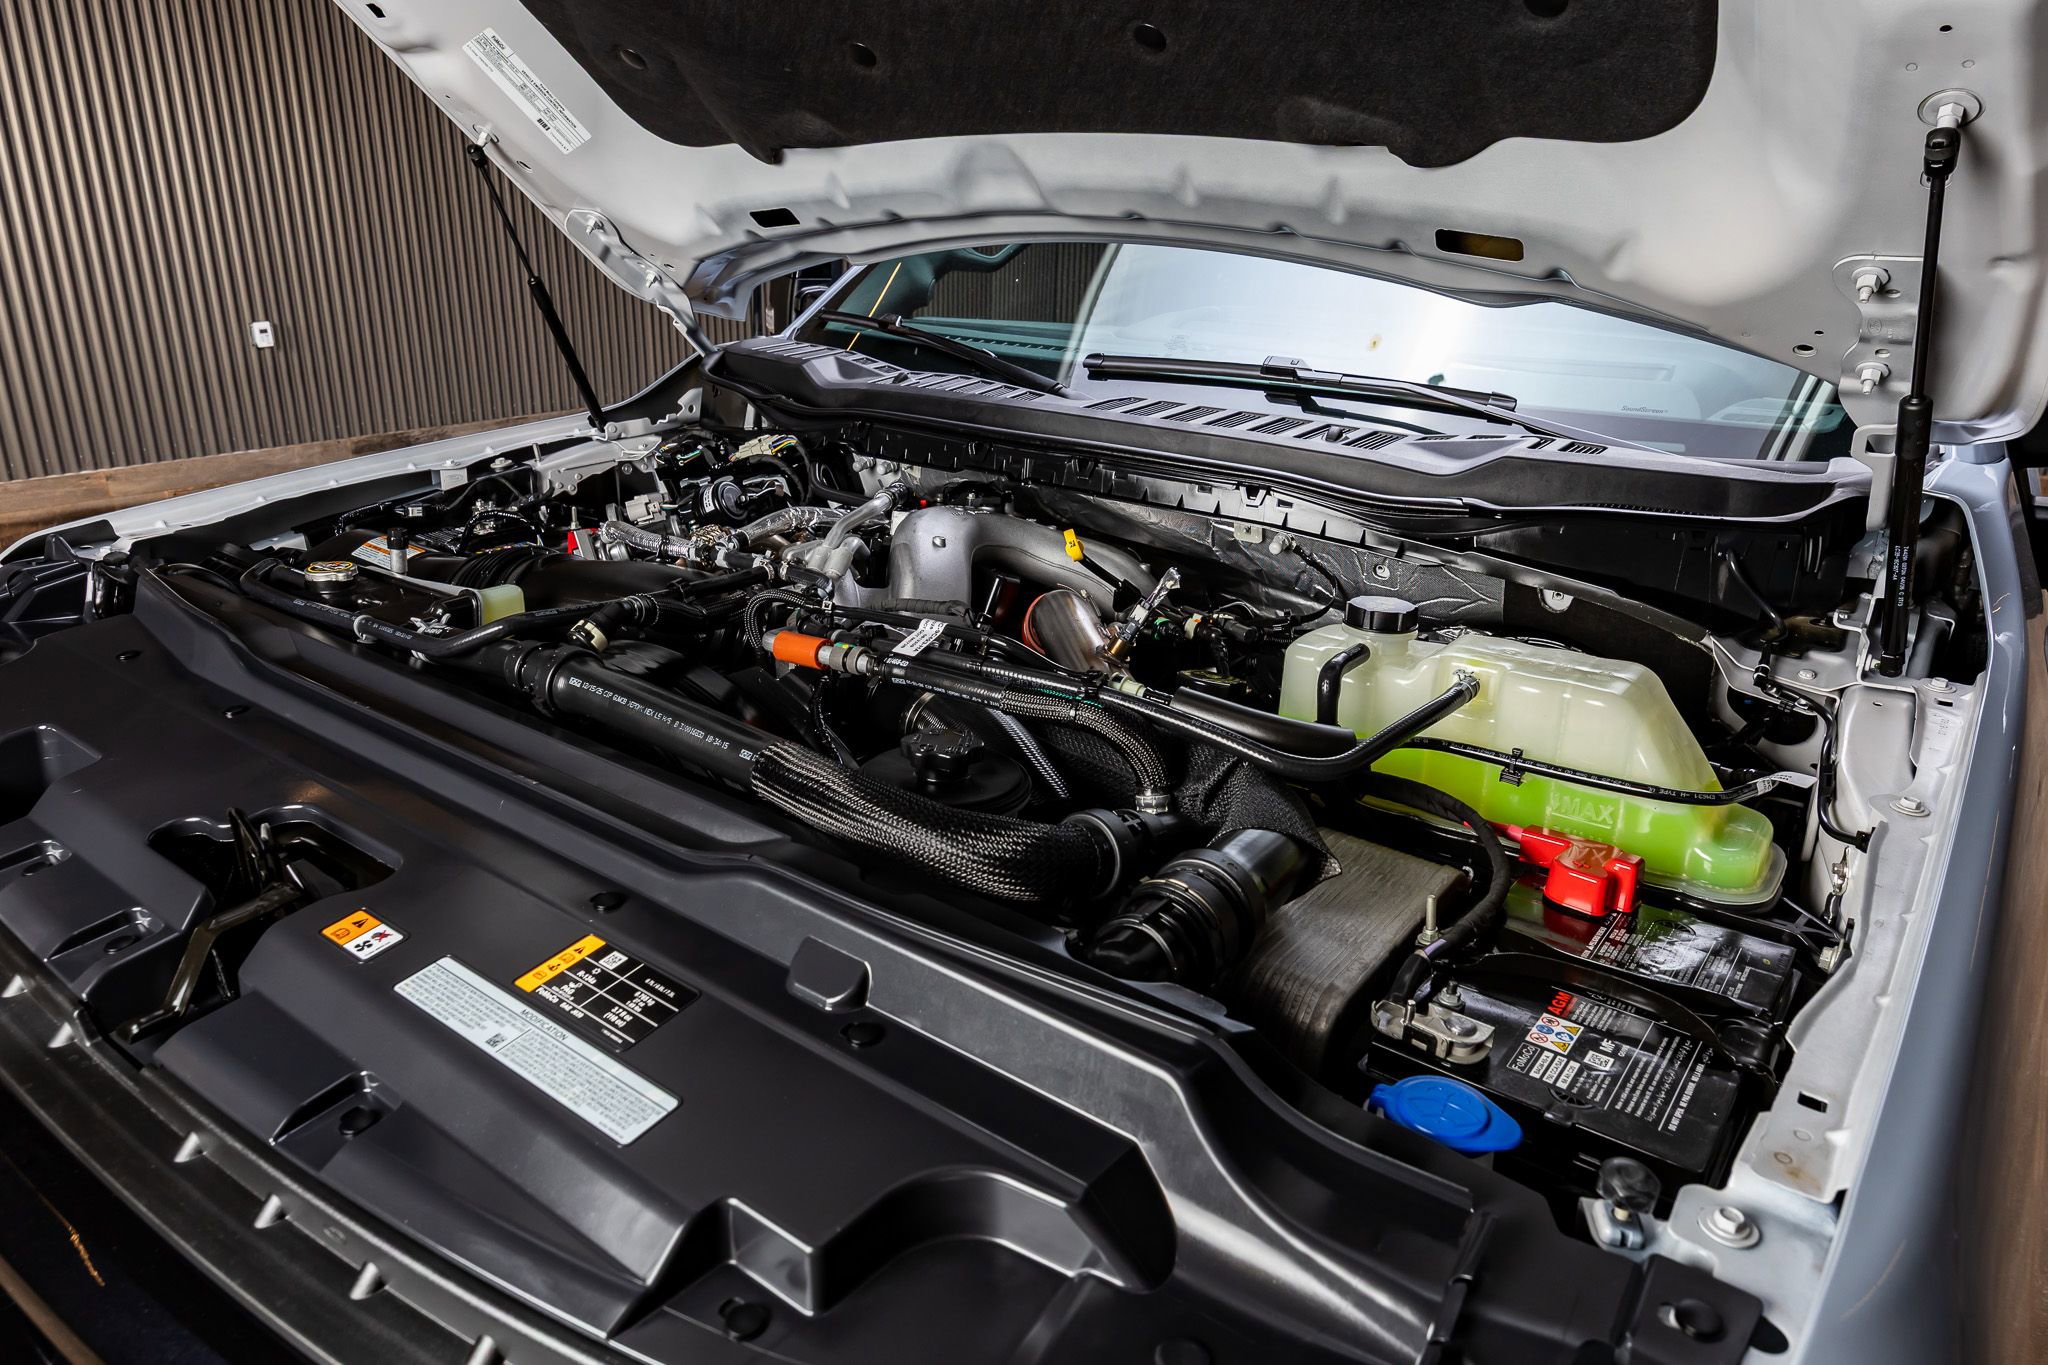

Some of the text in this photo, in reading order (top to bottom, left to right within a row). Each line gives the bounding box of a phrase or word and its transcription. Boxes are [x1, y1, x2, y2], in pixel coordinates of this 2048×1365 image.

[1547, 991, 1572, 1015] AGM
[520, 1010, 567, 1039] MODIFICATION
[1511, 1045, 1536, 1069] FoMoCo
[1600, 1038, 1616, 1053] MF
